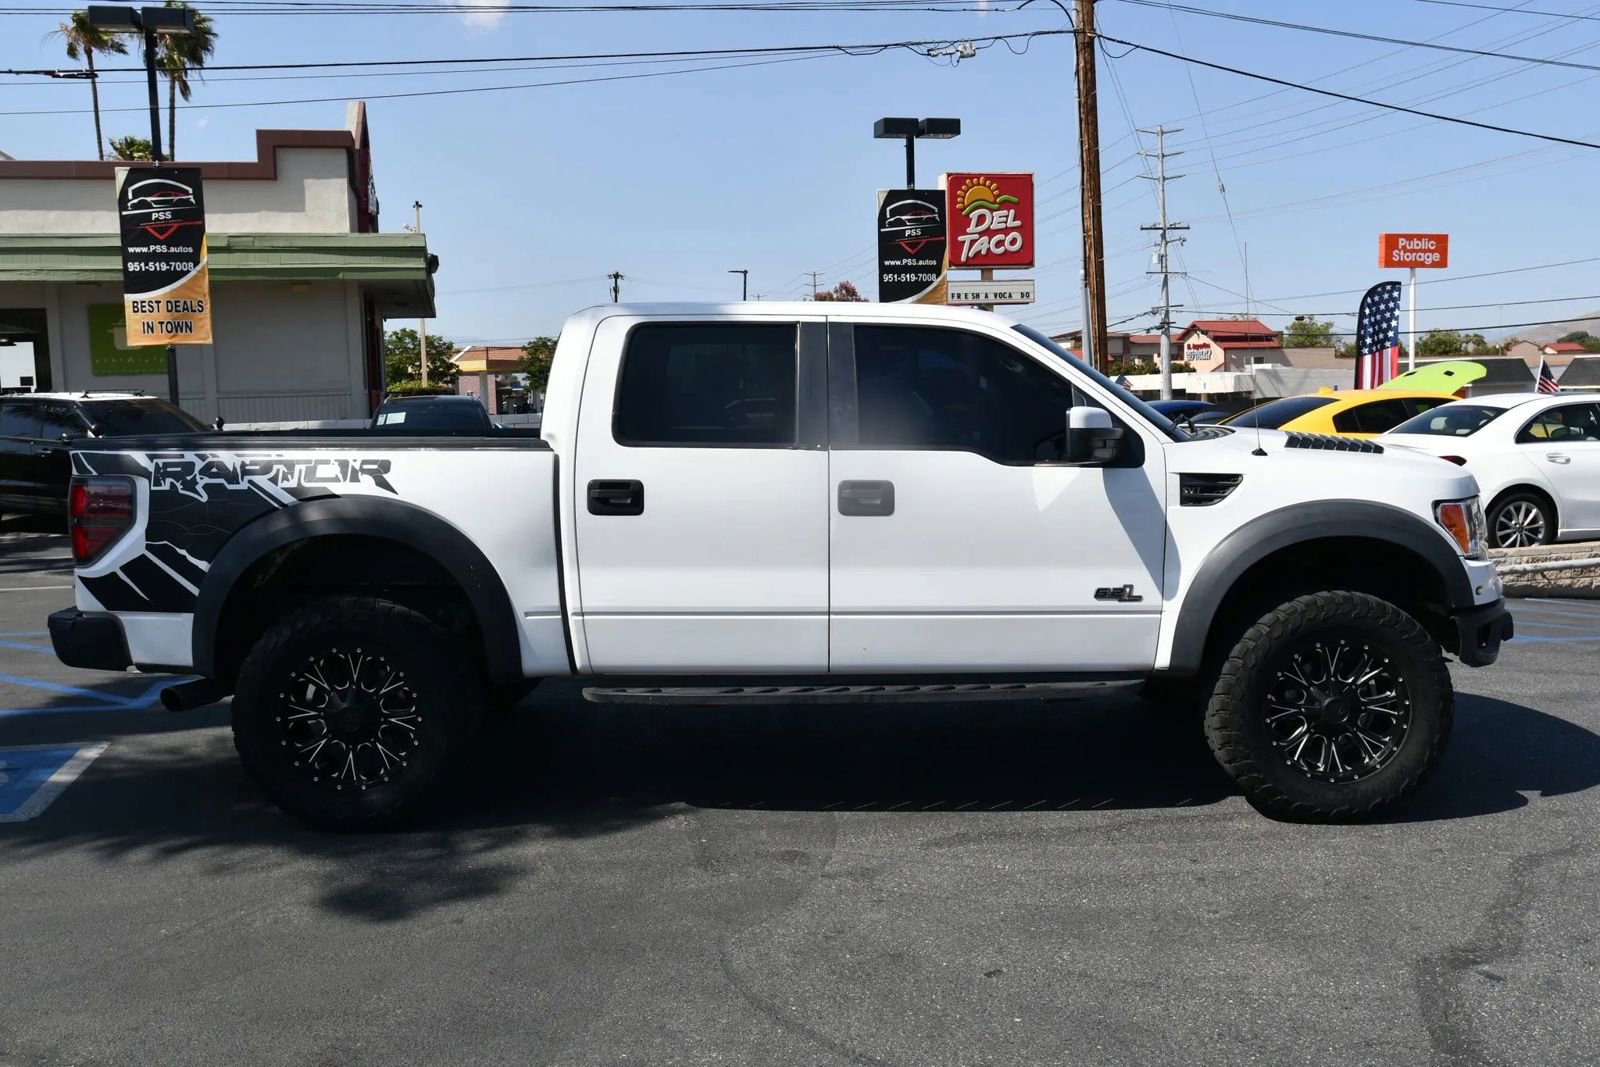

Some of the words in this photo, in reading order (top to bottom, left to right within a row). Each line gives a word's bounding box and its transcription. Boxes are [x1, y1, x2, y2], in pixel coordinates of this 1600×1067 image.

[151, 211, 172, 220] PSS
[966, 208, 1022, 233] DEL
[127, 245, 193, 253] www.PSS.autos
[957, 231, 1023, 262] TACO
[1398, 237, 1436, 249] Public
[1392, 249, 1440, 264] Storage
[127, 262, 194, 271] 951-519-7008
[883, 273, 937, 282] 951-519-7008
[132, 301, 161, 313] BEST
[166, 301, 204, 313] DEALS
[142, 321, 154, 334] IN
[158, 321, 193, 334] TOWN
[151, 457, 400, 501] RAPTOR
